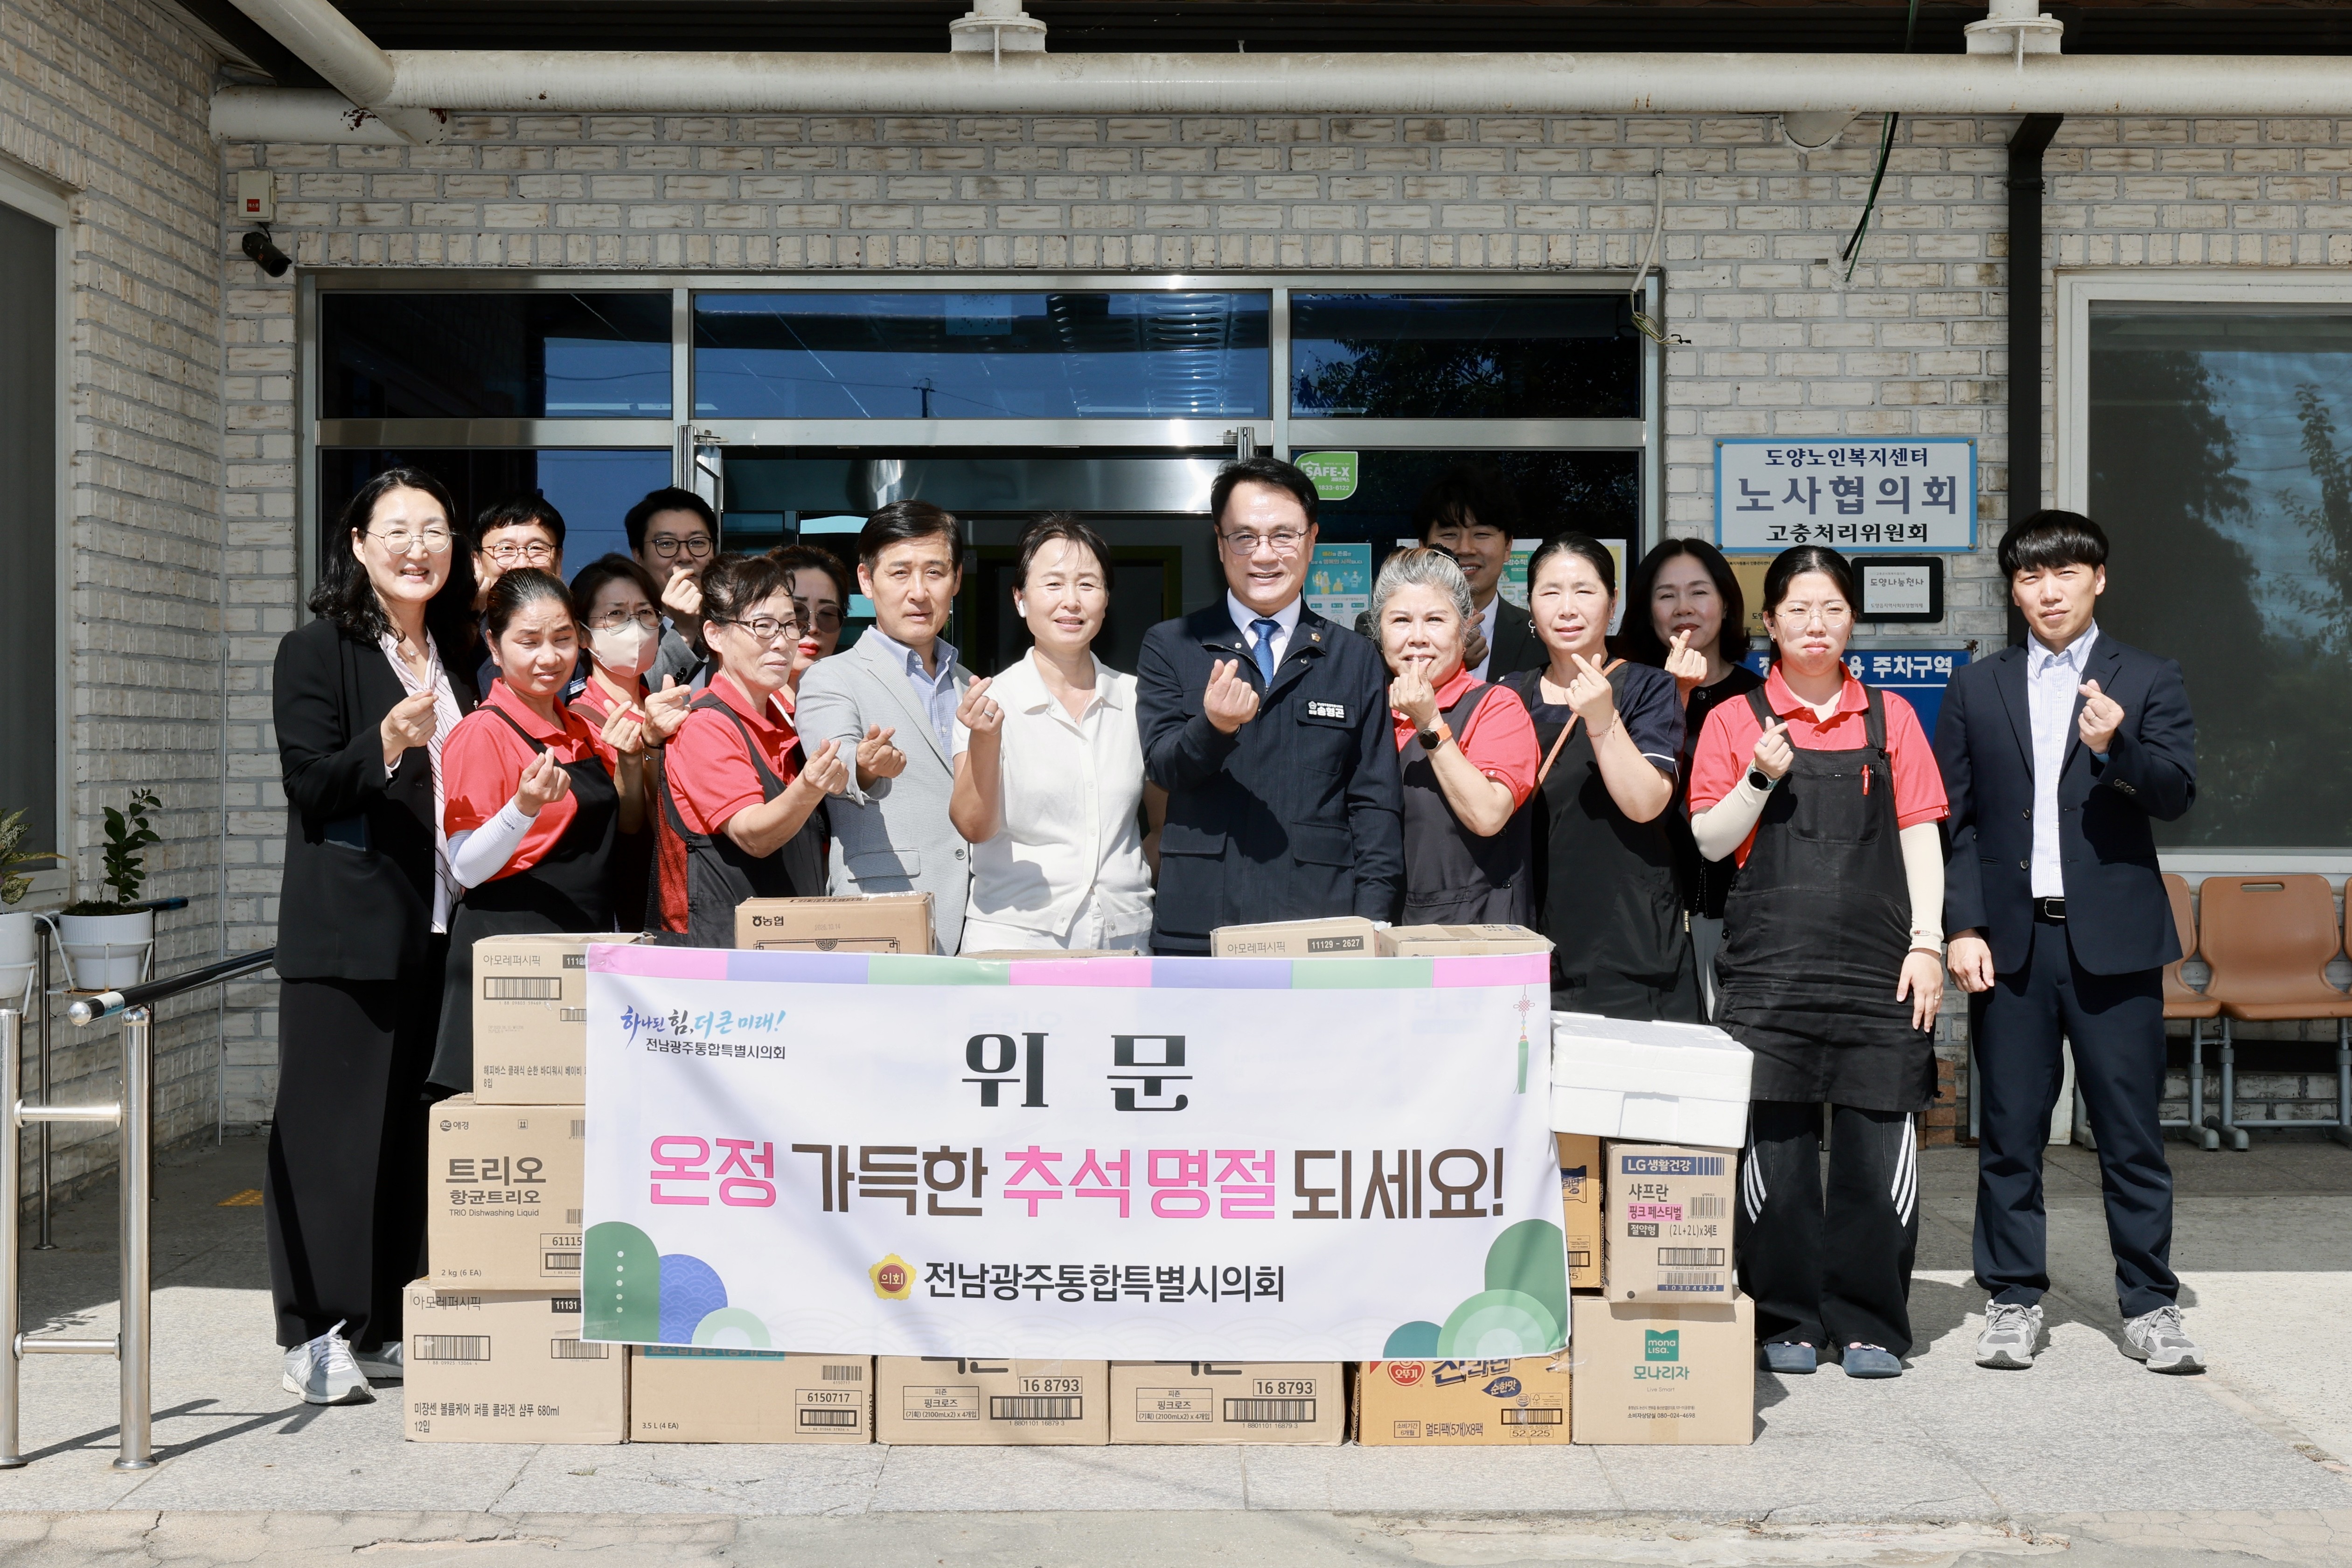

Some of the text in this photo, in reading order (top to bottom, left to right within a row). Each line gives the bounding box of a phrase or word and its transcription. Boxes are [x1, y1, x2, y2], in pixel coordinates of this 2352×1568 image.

[1765, 447, 1928, 467] 도양노인복지센터
[1306, 467, 1350, 477] SAFE-X
[1736, 475, 1956, 515] 노사협의회
[1766, 523, 1928, 543] 고충처리위원회
[1870, 577, 1924, 587] 도양나눔천사
[1873, 655, 1952, 679] 주차구역
[1317, 706, 1344, 718] 송형곤
[762, 916, 784, 927] 농협
[1227, 941, 1286, 955] 아모레퍼시픽
[1311, 940, 1334, 949] 11129
[1342, 938, 1360, 948] 2627
[483, 955, 541, 966] 아모레퍼시픽
[620, 1005, 666, 1051] 하나된
[715, 1010, 734, 1035] 큰
[738, 1010, 786, 1033] 미래!
[646, 1038, 786, 1059] 전남광주통합특별시의회
[484, 1065, 506, 1075] 해피바스
[508, 1065, 525, 1076] 클래식
[527, 1066, 538, 1076] 순한
[541, 1066, 563, 1076] 바디워시
[565, 1066, 582, 1076] 베이비
[484, 1078, 493, 1088] 8입
[453, 1121, 469, 1130] 애경
[445, 1156, 547, 1186] 트리오
[1628, 1159, 1691, 1172] LG 생활건강
[650, 1135, 1504, 1220] 온정 가득한 추석 명절 되세요!
[1562, 1178, 1580, 1189] 라면
[449, 1190, 541, 1205] 항균트리오
[1628, 1183, 1669, 1202] 샤프란
[469, 1209, 514, 1217] Dishwashing
[516, 1209, 539, 1217] Liquid
[1629, 1205, 1682, 1220] 핑크 페스티벌
[1630, 1225, 1656, 1236] 절약형
[552, 1237, 582, 1246] 61115
[880, 1272, 904, 1286] 의회
[924, 1261, 1284, 1303] 전남광주통합특별시의회
[413, 1296, 481, 1311] 아모레퍼시픽
[556, 1300, 578, 1310] 11131
[1395, 1369, 1418, 1379] 오뚜기
[1633, 1366, 1690, 1380] 모나리자
[1023, 1379, 1079, 1393] 16 8793
[1256, 1381, 1313, 1394] 16 8793
[1490, 1380, 1517, 1395] 순한맛
[807, 1393, 850, 1403] 6150717
[924, 1399, 958, 1408] 핑크로즈
[414, 1402, 560, 1416] 미쟝센 볼륨케어 퍼플 콜라겐 샴푸 680ml
[1157, 1401, 1191, 1410] 핑크로즈
[414, 1420, 430, 1433] 12입
